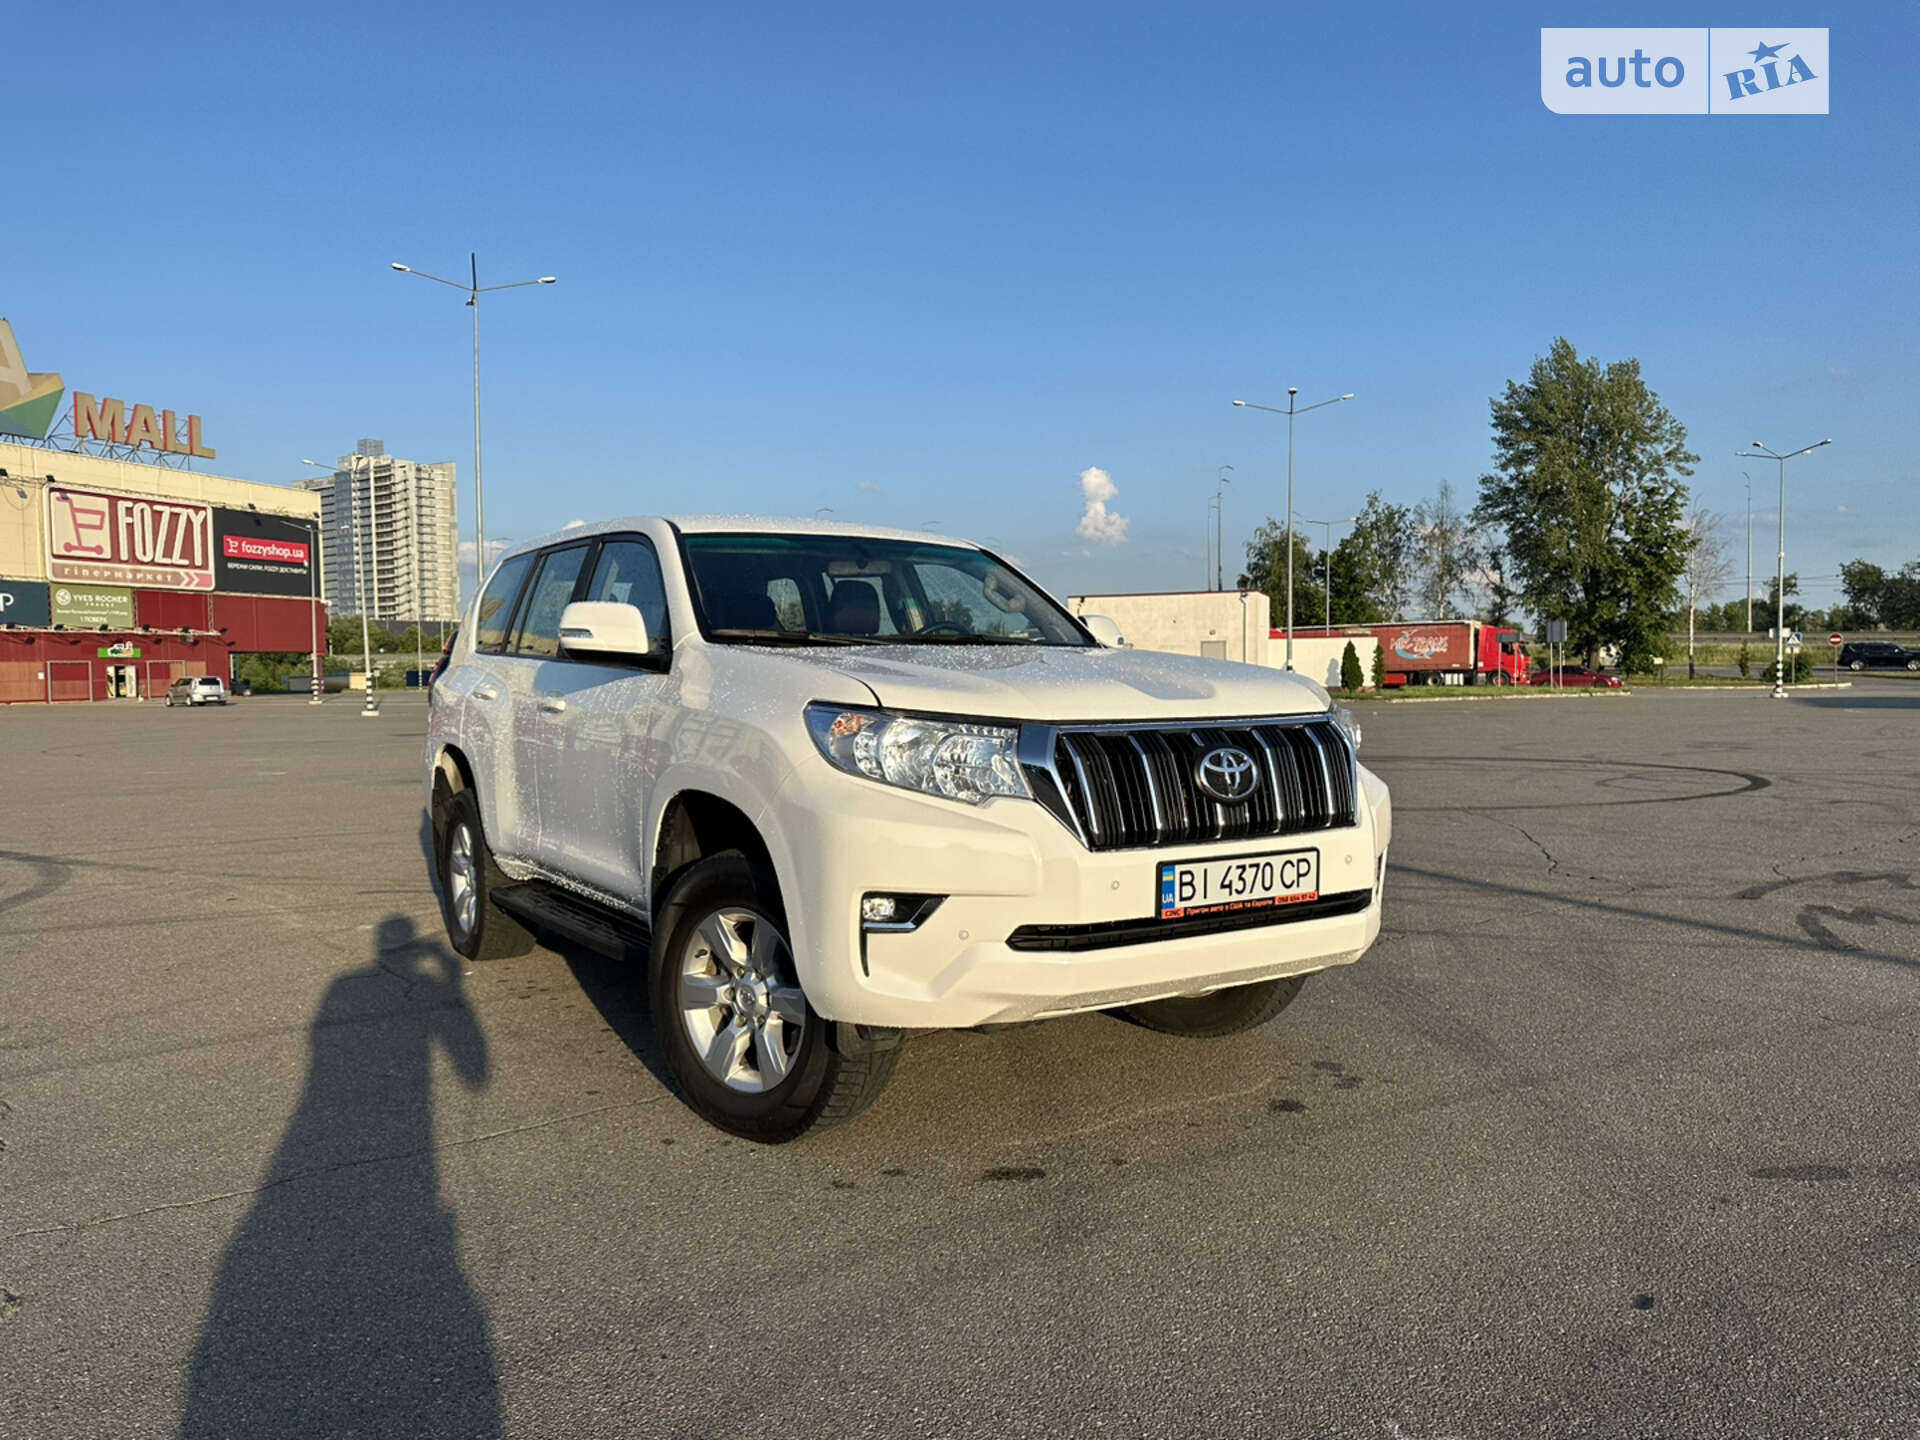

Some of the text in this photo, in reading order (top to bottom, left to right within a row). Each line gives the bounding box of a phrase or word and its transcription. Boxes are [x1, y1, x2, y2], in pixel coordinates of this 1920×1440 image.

[73, 391, 216, 459] MALL
[117, 500, 207, 567] FOZZY
[241, 540, 304, 558] fozzyshop.ua
[72, 594, 128, 603] YVES ROCHER
[1179, 858, 1311, 902] BI 4370 CP
[1162, 892, 1174, 904] UA
